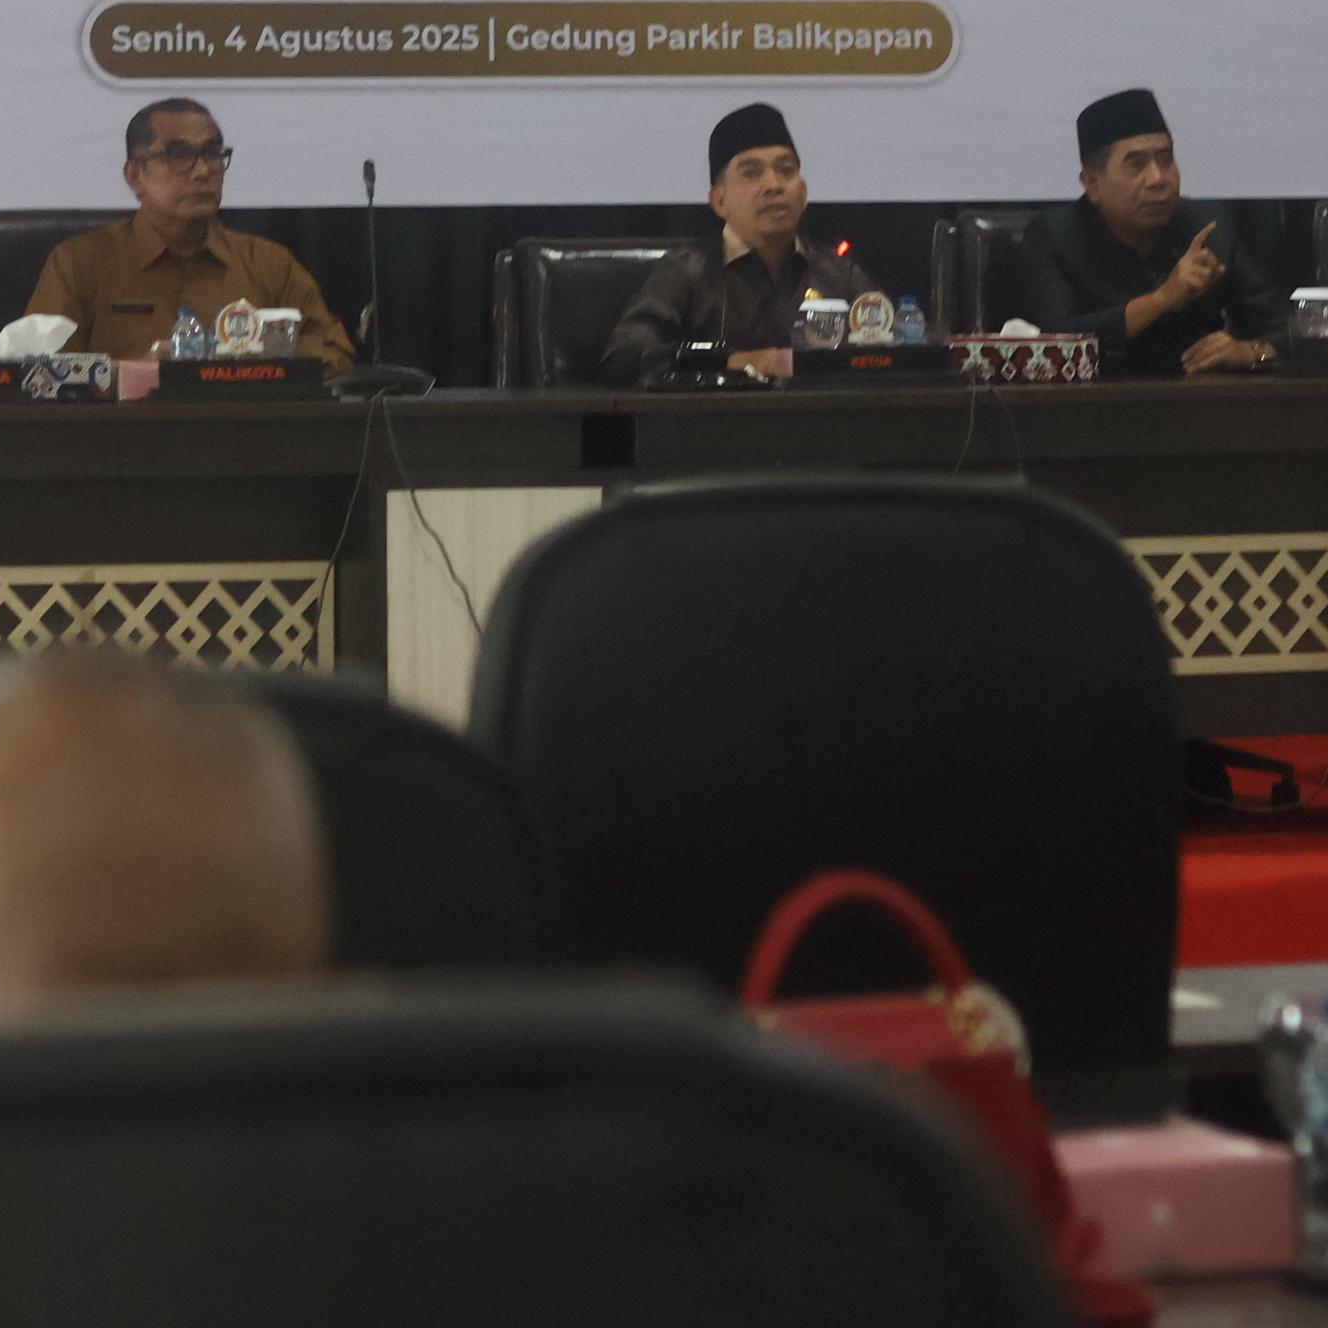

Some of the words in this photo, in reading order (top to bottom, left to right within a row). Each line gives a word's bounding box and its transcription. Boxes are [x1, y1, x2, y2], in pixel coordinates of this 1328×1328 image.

[110, 22, 215, 58] Senin,
[224, 24, 247, 53] 4
[254, 24, 393, 59] Agustus
[401, 23, 480, 52] 2025
[505, 22, 636, 57] Gedung
[646, 21, 744, 51] Parkir
[752, 20, 933, 56] Balikpapan
